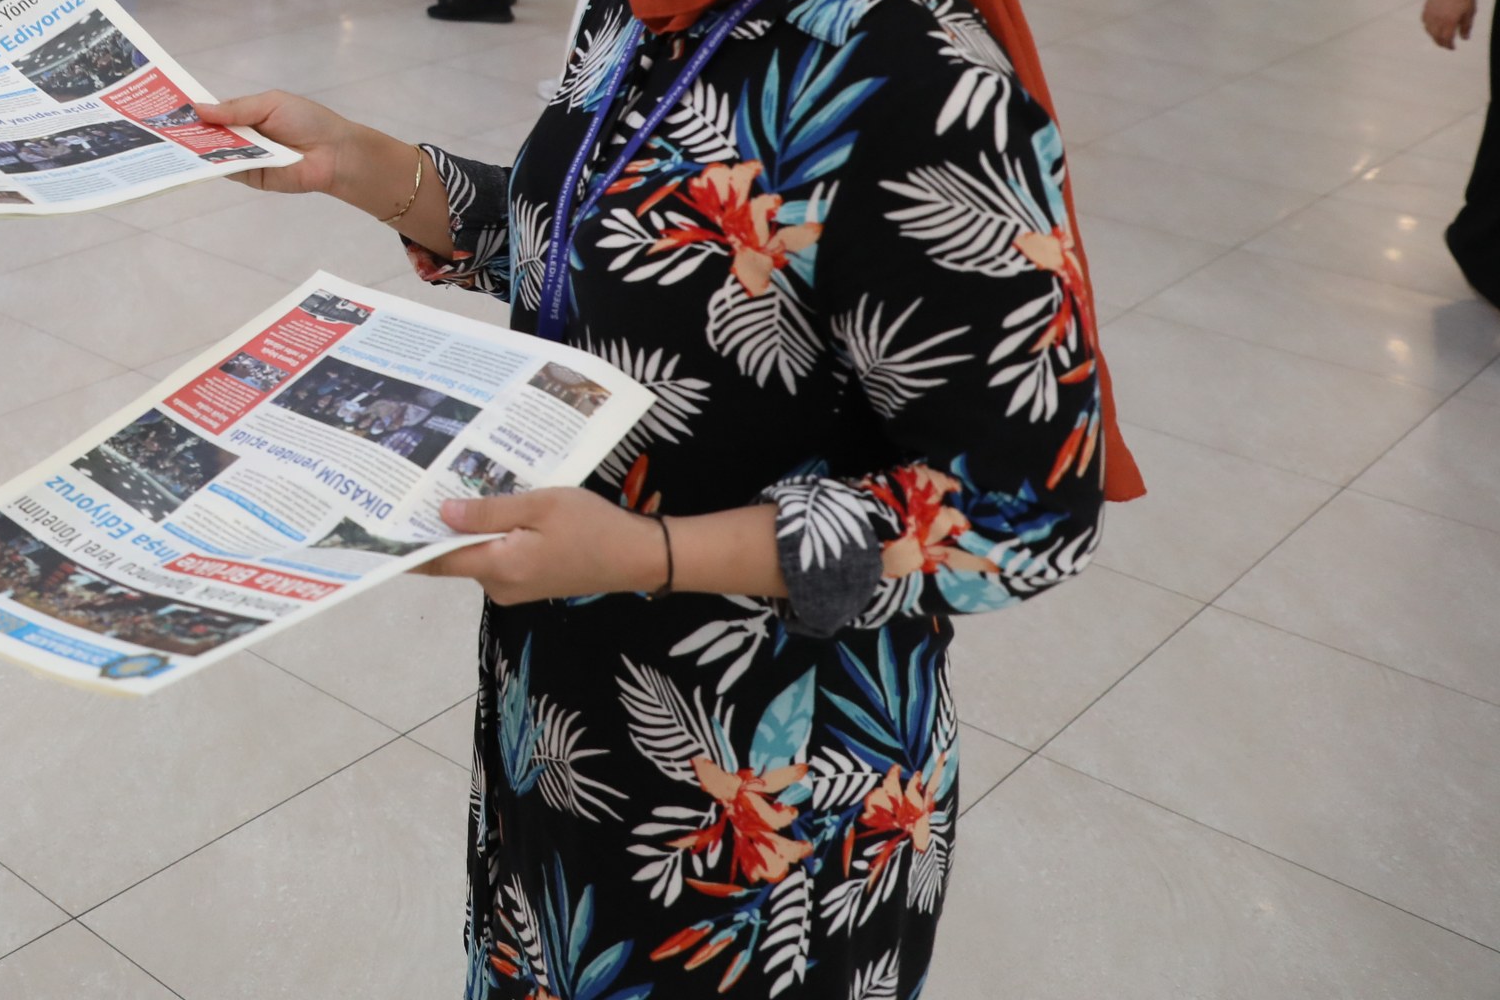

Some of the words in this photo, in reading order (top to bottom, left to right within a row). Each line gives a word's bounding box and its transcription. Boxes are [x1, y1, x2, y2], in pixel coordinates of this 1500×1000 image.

[8, 108, 61, 126] yeniden
[230, 428, 269, 450] açıldı
[267, 443, 323, 472] yeniden
[44, 474, 135, 541] Ediyoruz
[315, 466, 393, 521] DİKASUM
[7, 495, 82, 548] Yönetimi
[72, 539, 122, 570] Yerel
[131, 532, 182, 567] İnşa
[175, 556, 258, 584] Birlikte
[253, 572, 335, 600] Halkla
